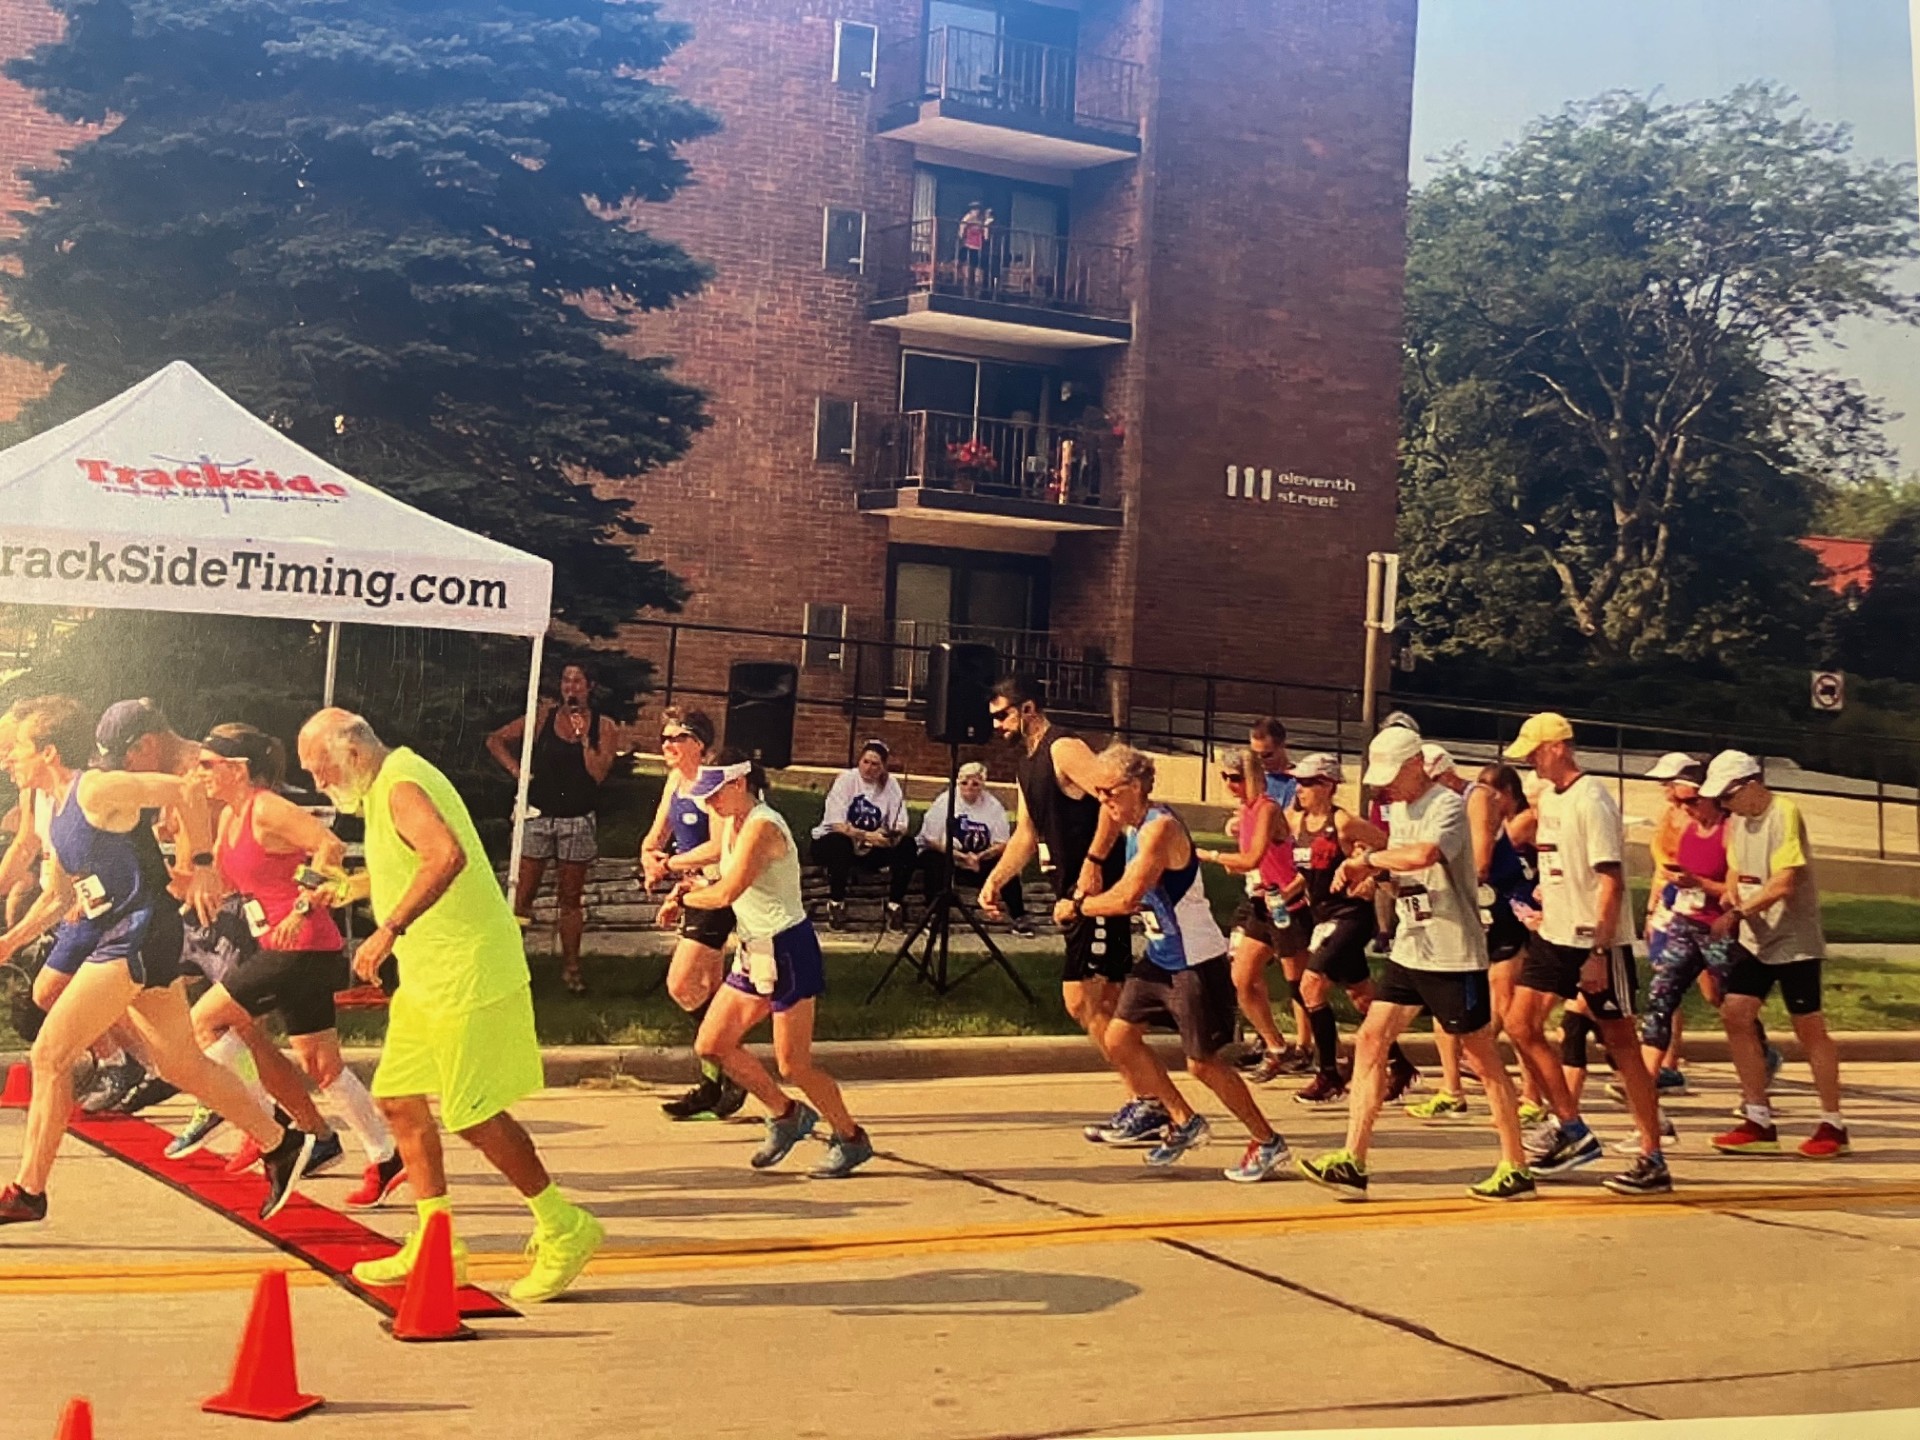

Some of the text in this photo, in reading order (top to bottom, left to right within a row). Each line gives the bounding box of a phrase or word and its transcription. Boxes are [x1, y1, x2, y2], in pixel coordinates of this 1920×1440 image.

[1226, 464, 1273, 500] 111
[1278, 472, 1356, 492] eleventh
[1277, 491, 1339, 508] street
